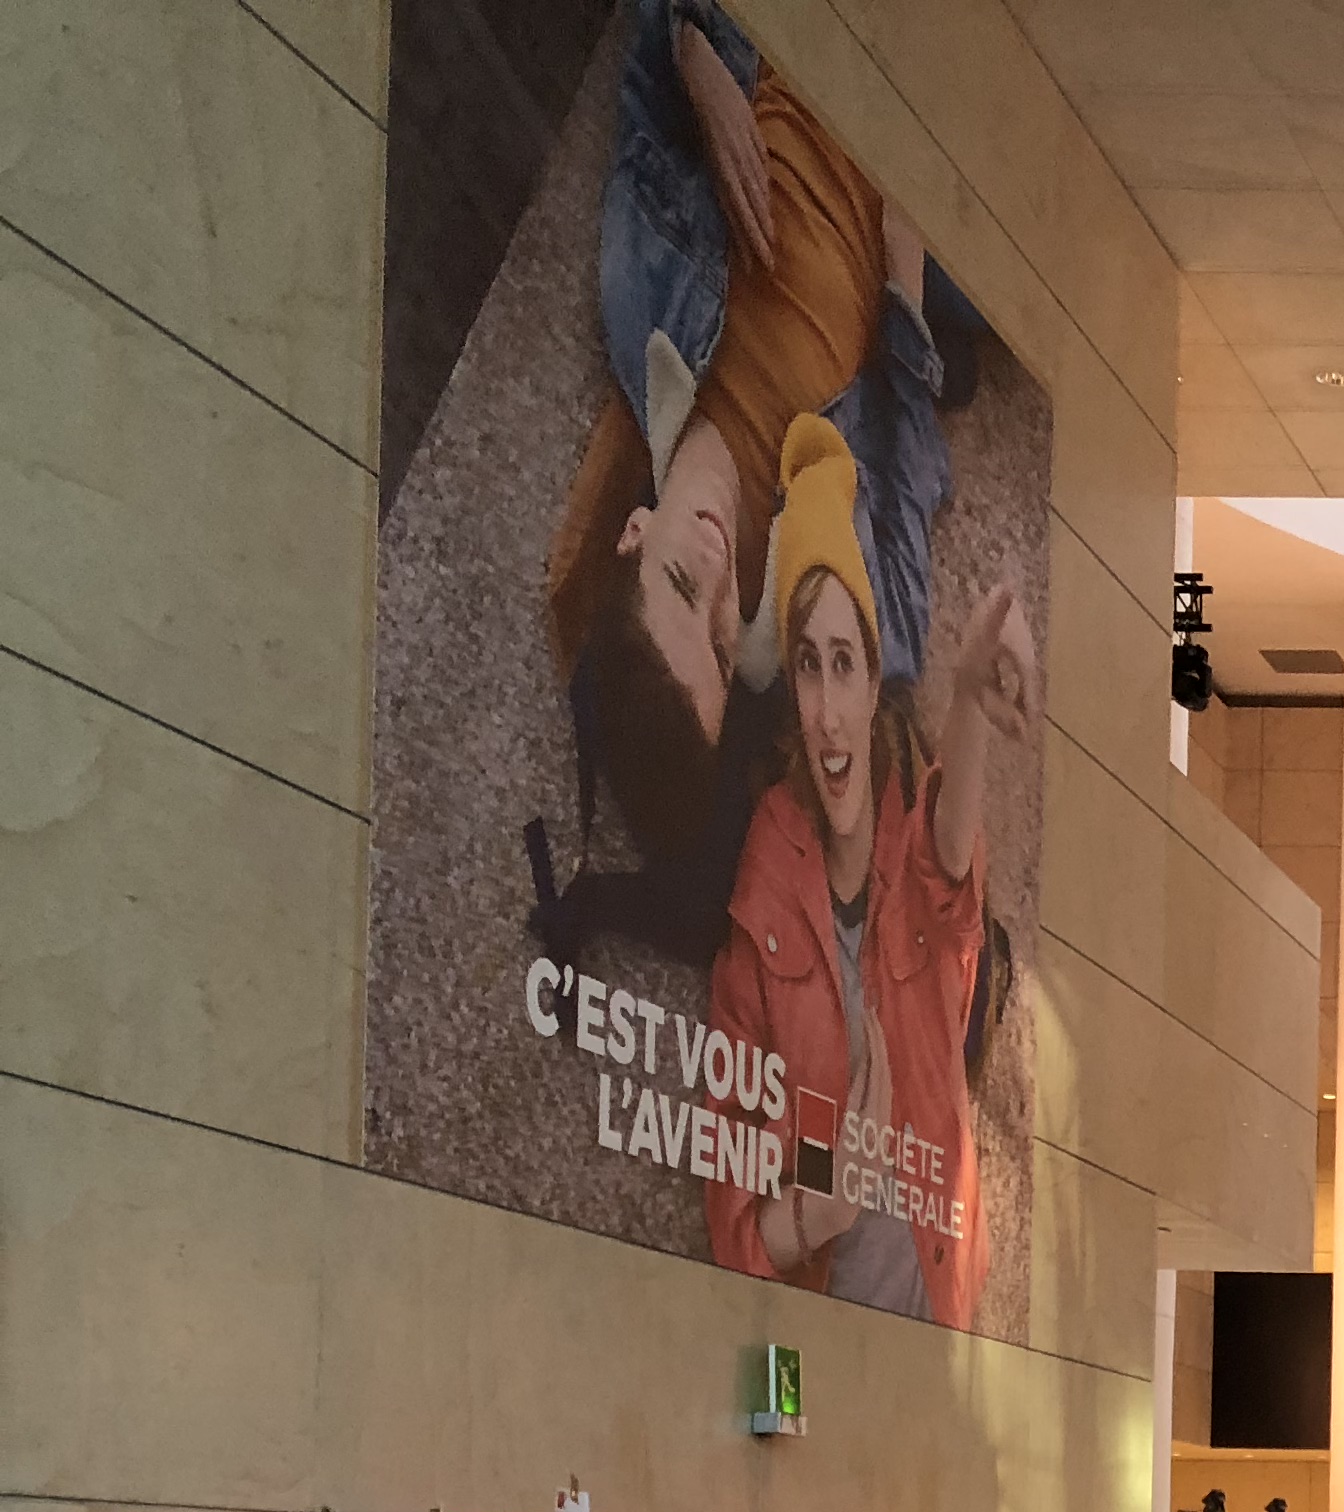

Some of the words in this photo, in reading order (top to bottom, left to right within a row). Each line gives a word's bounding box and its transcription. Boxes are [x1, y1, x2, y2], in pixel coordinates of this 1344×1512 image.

[524, 957, 666, 1076] C'EST
[673, 1014, 787, 1120] VOUS
[597, 1074, 783, 1200] L'AVENIR
[842, 1161, 966, 1243] GENERALE
